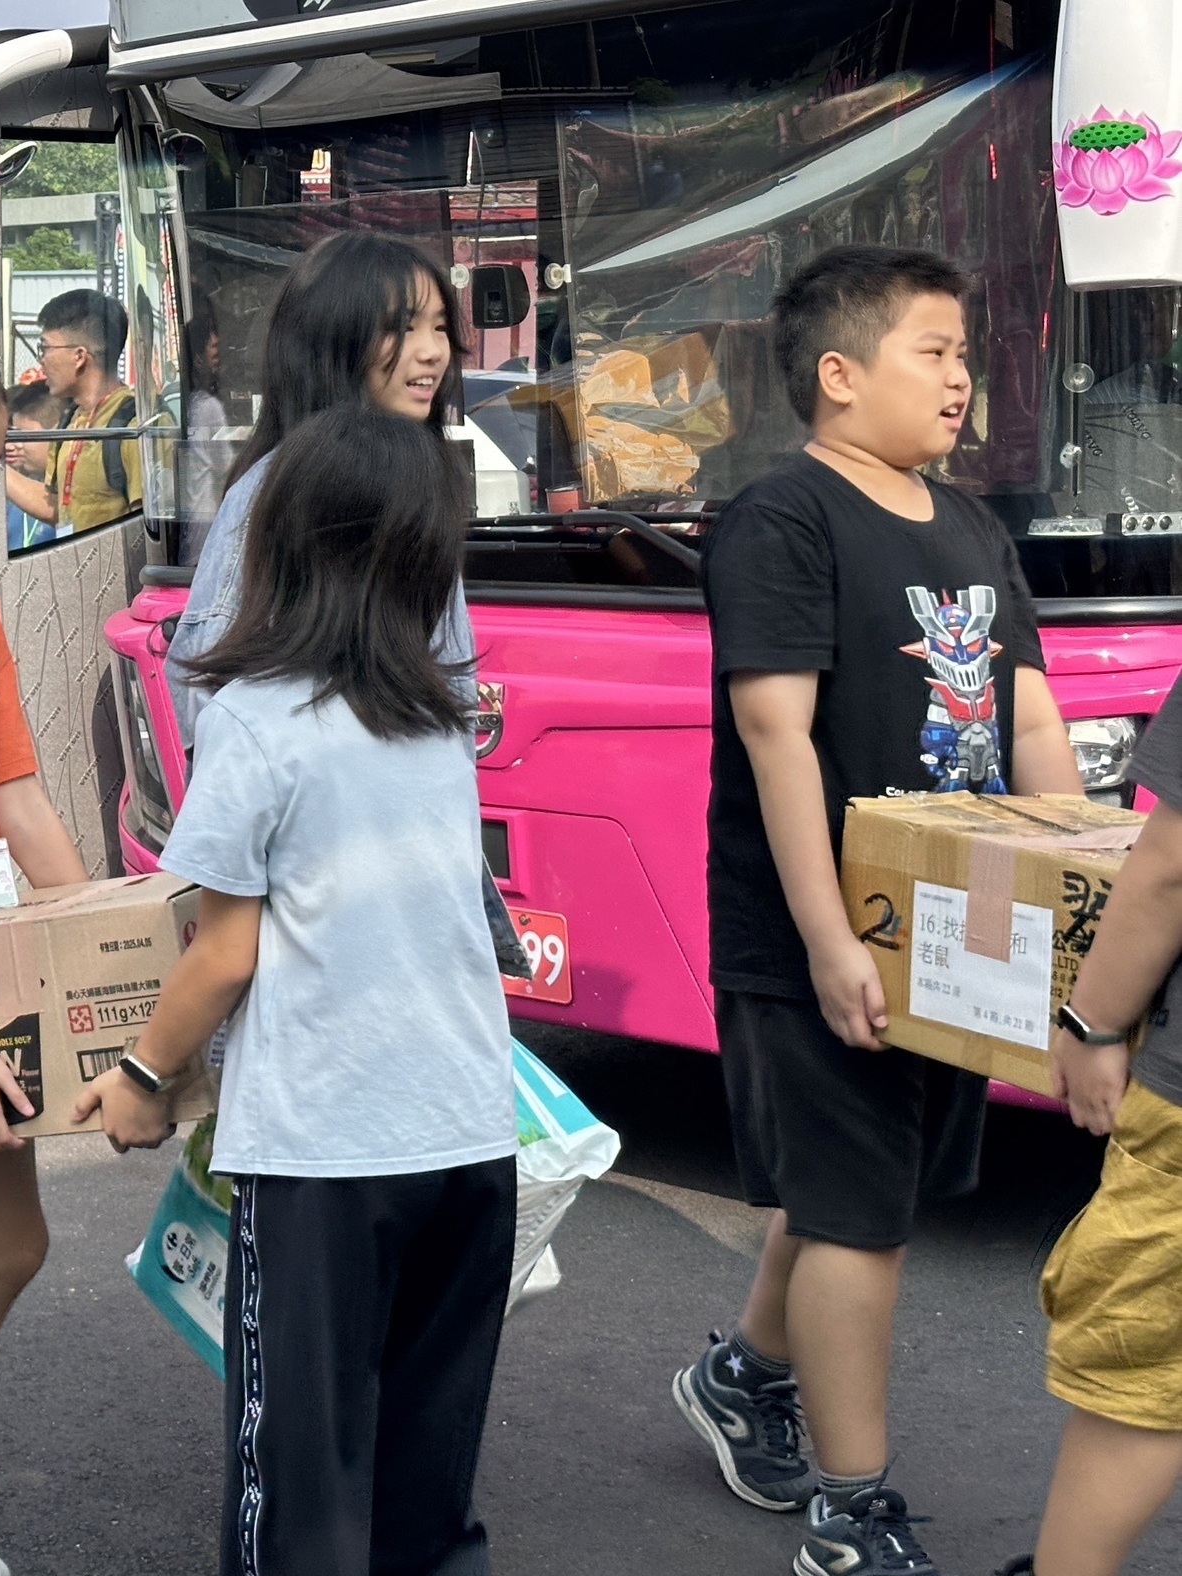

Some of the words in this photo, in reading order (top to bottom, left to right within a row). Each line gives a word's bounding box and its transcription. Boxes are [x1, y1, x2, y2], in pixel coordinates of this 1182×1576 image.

[860, 893, 902, 951] 2
[508, 930, 565, 987] 99
[918, 941, 950, 969] 老鼠
